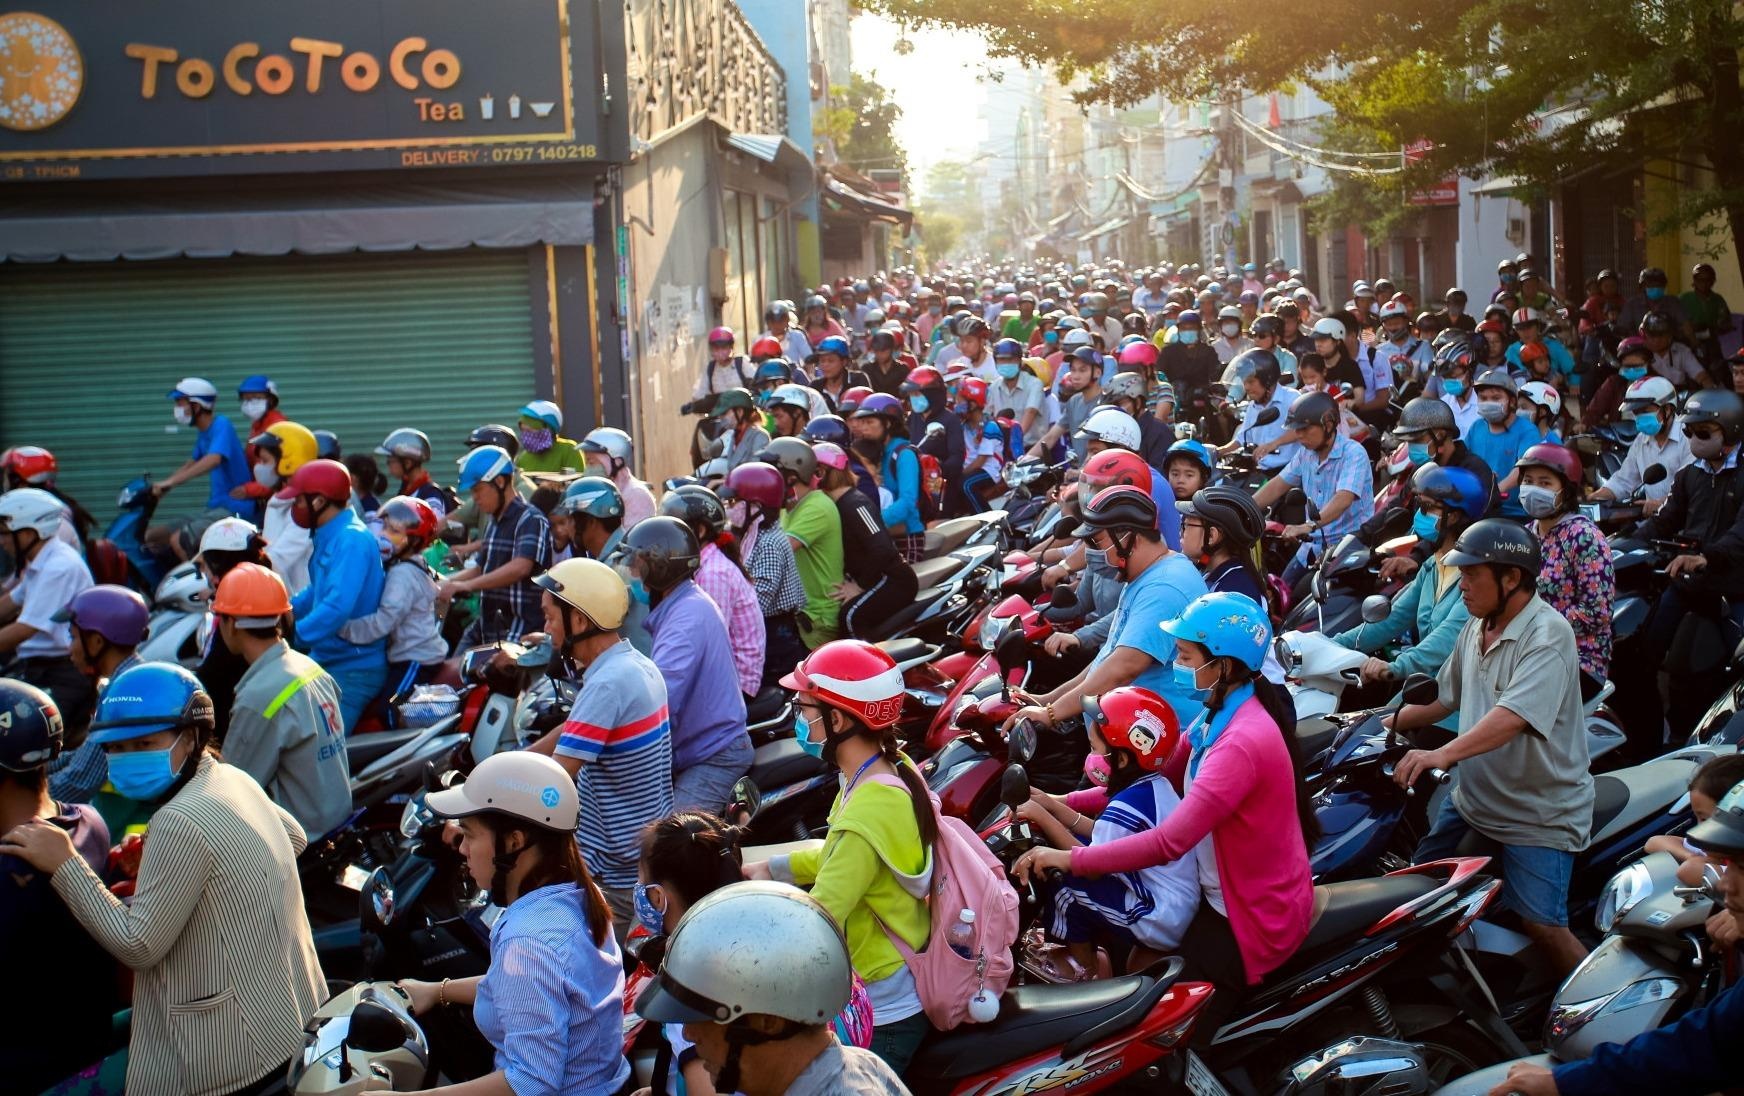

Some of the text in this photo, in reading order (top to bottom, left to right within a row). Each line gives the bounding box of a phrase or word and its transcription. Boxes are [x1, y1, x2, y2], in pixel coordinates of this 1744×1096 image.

[414, 97, 464, 121] Tea
[401, 150, 479, 167] DELIVERY
[492, 147, 534, 163] 0797
[537, 144, 597, 161] 140218
[1505, 541, 1516, 553] My
[1517, 543, 1531, 554] Bike
[423, 948, 467, 966] HONDA
